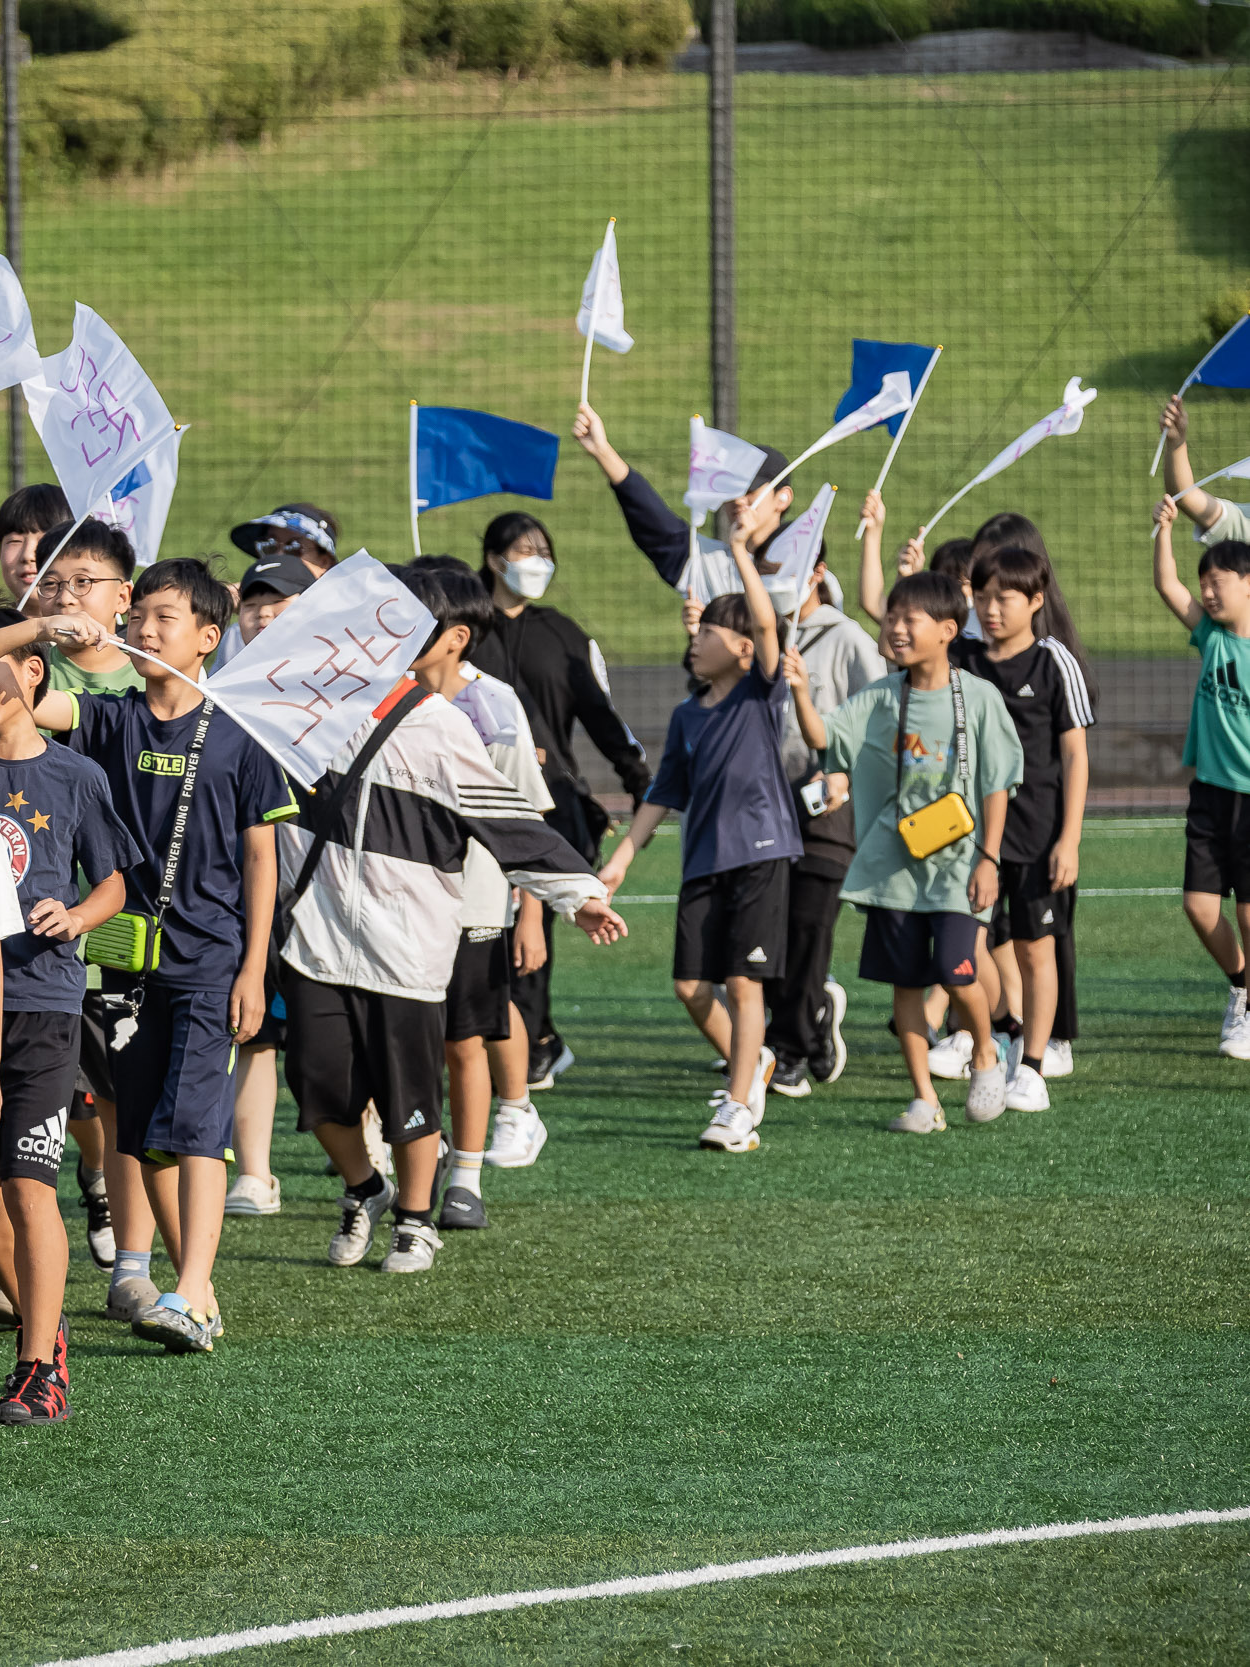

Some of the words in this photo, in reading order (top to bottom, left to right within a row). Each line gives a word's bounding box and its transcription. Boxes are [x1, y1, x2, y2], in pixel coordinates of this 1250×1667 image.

[141, 754, 182, 773] STYLE
[163, 841, 182, 889] FOREVER
[173, 804, 189, 844] YOUNG
[182, 751, 200, 798] FOREVER
